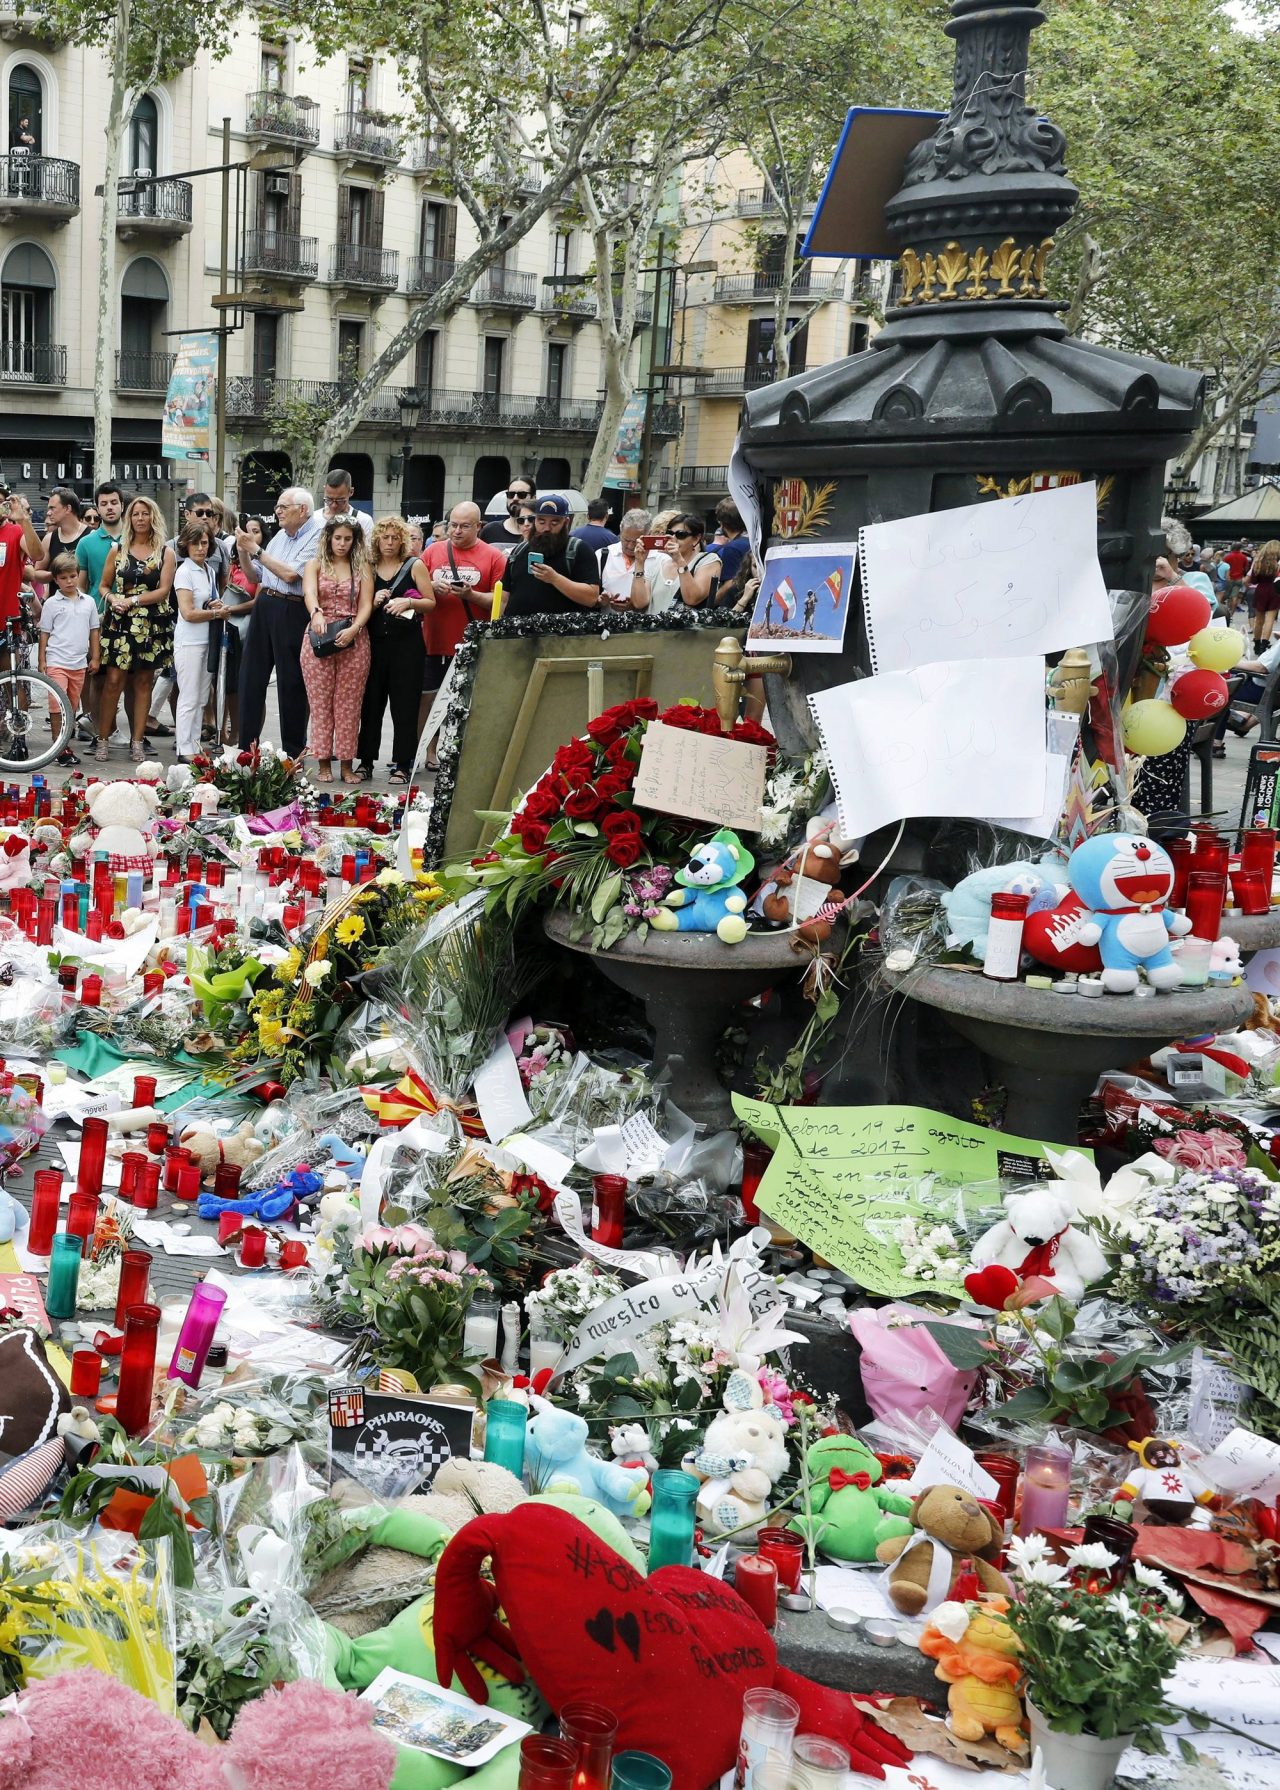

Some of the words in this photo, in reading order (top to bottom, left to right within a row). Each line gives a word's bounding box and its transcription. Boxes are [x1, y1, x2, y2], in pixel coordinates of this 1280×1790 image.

[23, 464, 83, 480] CLUB
[110, 464, 172, 480] APITOL
[1259, 775, 1268, 791] NEWS
[1257, 792, 1266, 807] NBC
[1264, 775, 1276, 808] LONDON
[895, 1118, 916, 1133] de
[807, 1140, 830, 1157] de
[850, 1141, 906, 1155] 2017
[331, 1388, 362, 1396] BARCELONA
[1210, 1390, 1239, 1399] DARIO
[365, 1411, 446, 1434] PHARAOHS
